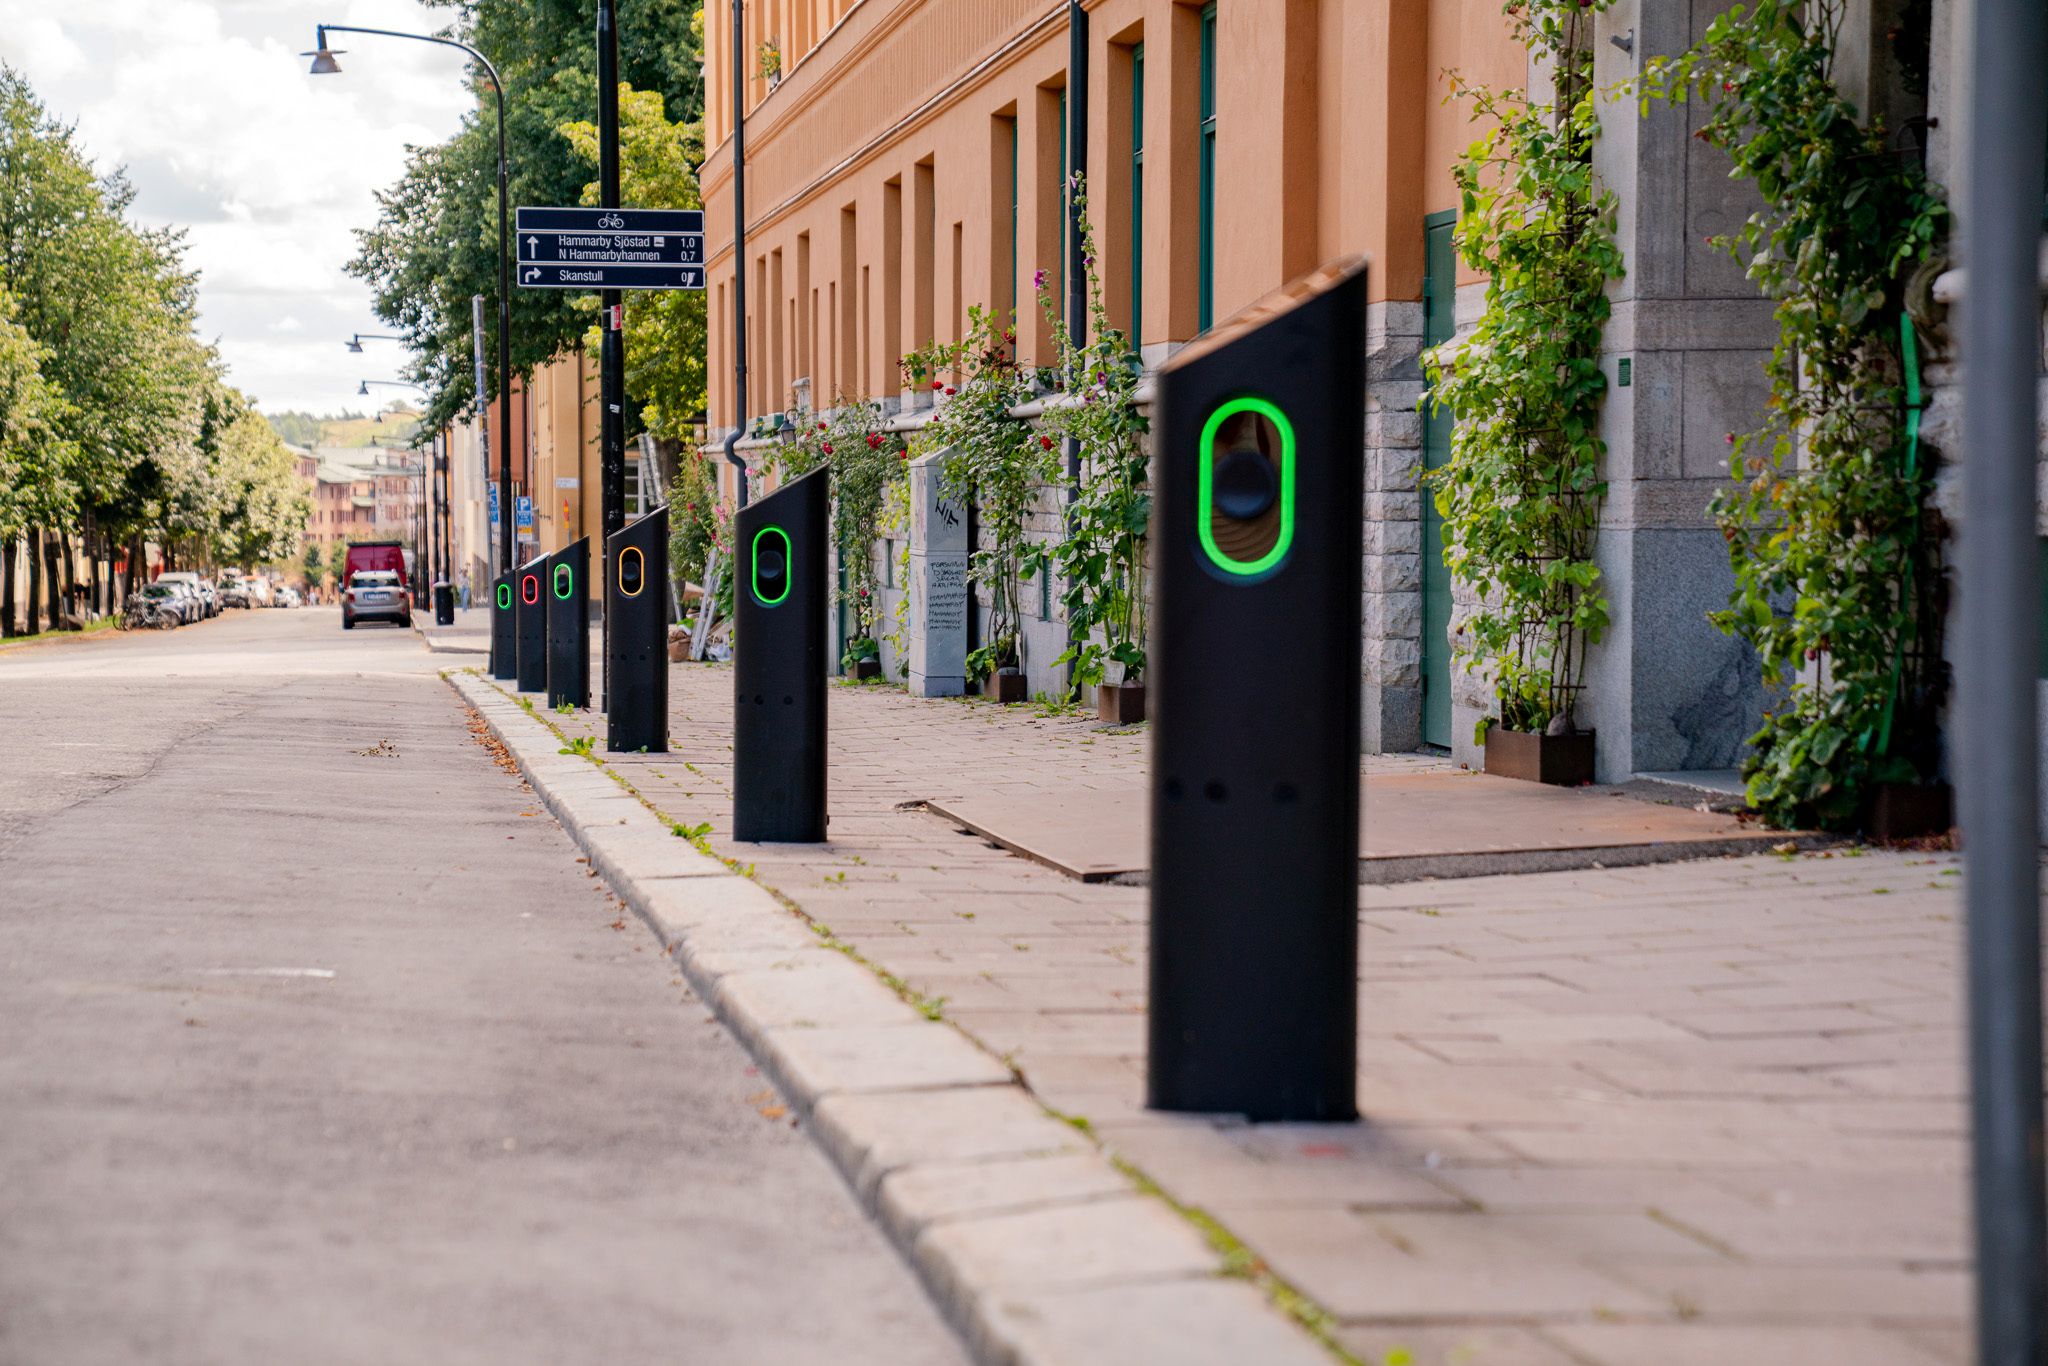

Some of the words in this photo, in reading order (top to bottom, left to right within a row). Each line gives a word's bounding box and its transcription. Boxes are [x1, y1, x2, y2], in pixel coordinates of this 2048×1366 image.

[558, 235, 611, 248] Hammarby
[614, 236, 650, 248] Sjöstad
[680, 238, 695, 249] 1,0
[558, 249, 566, 259] N
[568, 249, 660, 262] Hammarbyhamnen
[680, 252, 695, 262] 0,7
[559, 270, 603, 282] Skanstull
